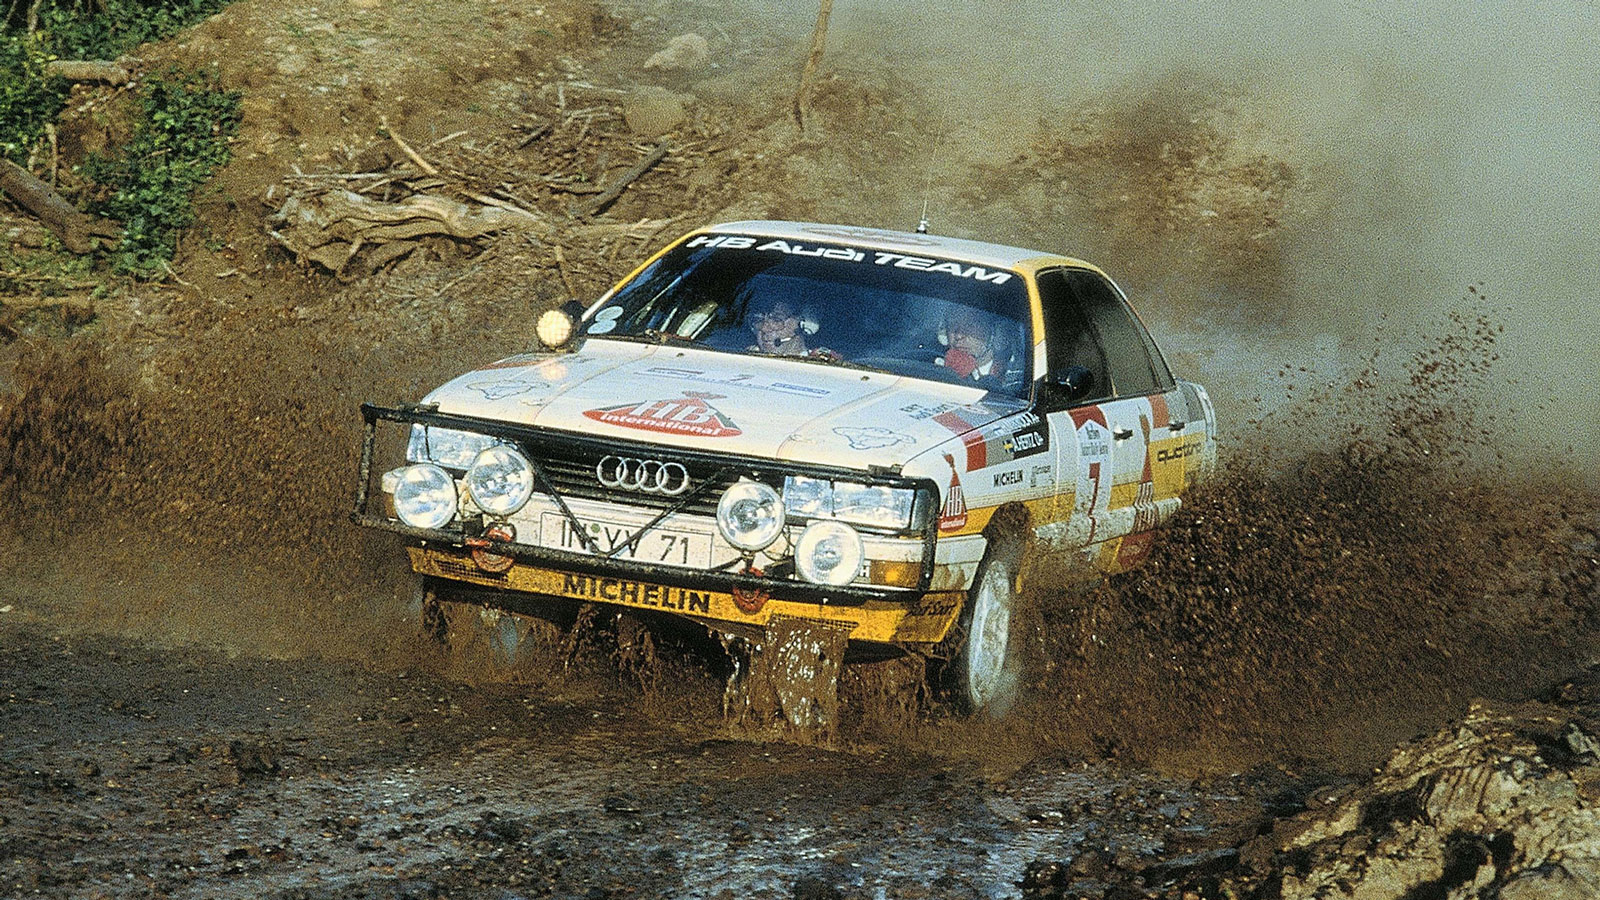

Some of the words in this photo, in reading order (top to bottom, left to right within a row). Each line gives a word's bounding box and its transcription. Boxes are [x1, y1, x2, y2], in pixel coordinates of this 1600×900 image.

[686, 236, 757, 250] HB
[874, 252, 1012, 285] TEAM
[629, 399, 717, 423] HB
[993, 469, 1023, 487] MICHELIN
[946, 486, 962, 517] HB
[660, 534, 689, 564] 71
[563, 575, 711, 613] MICHELIN
